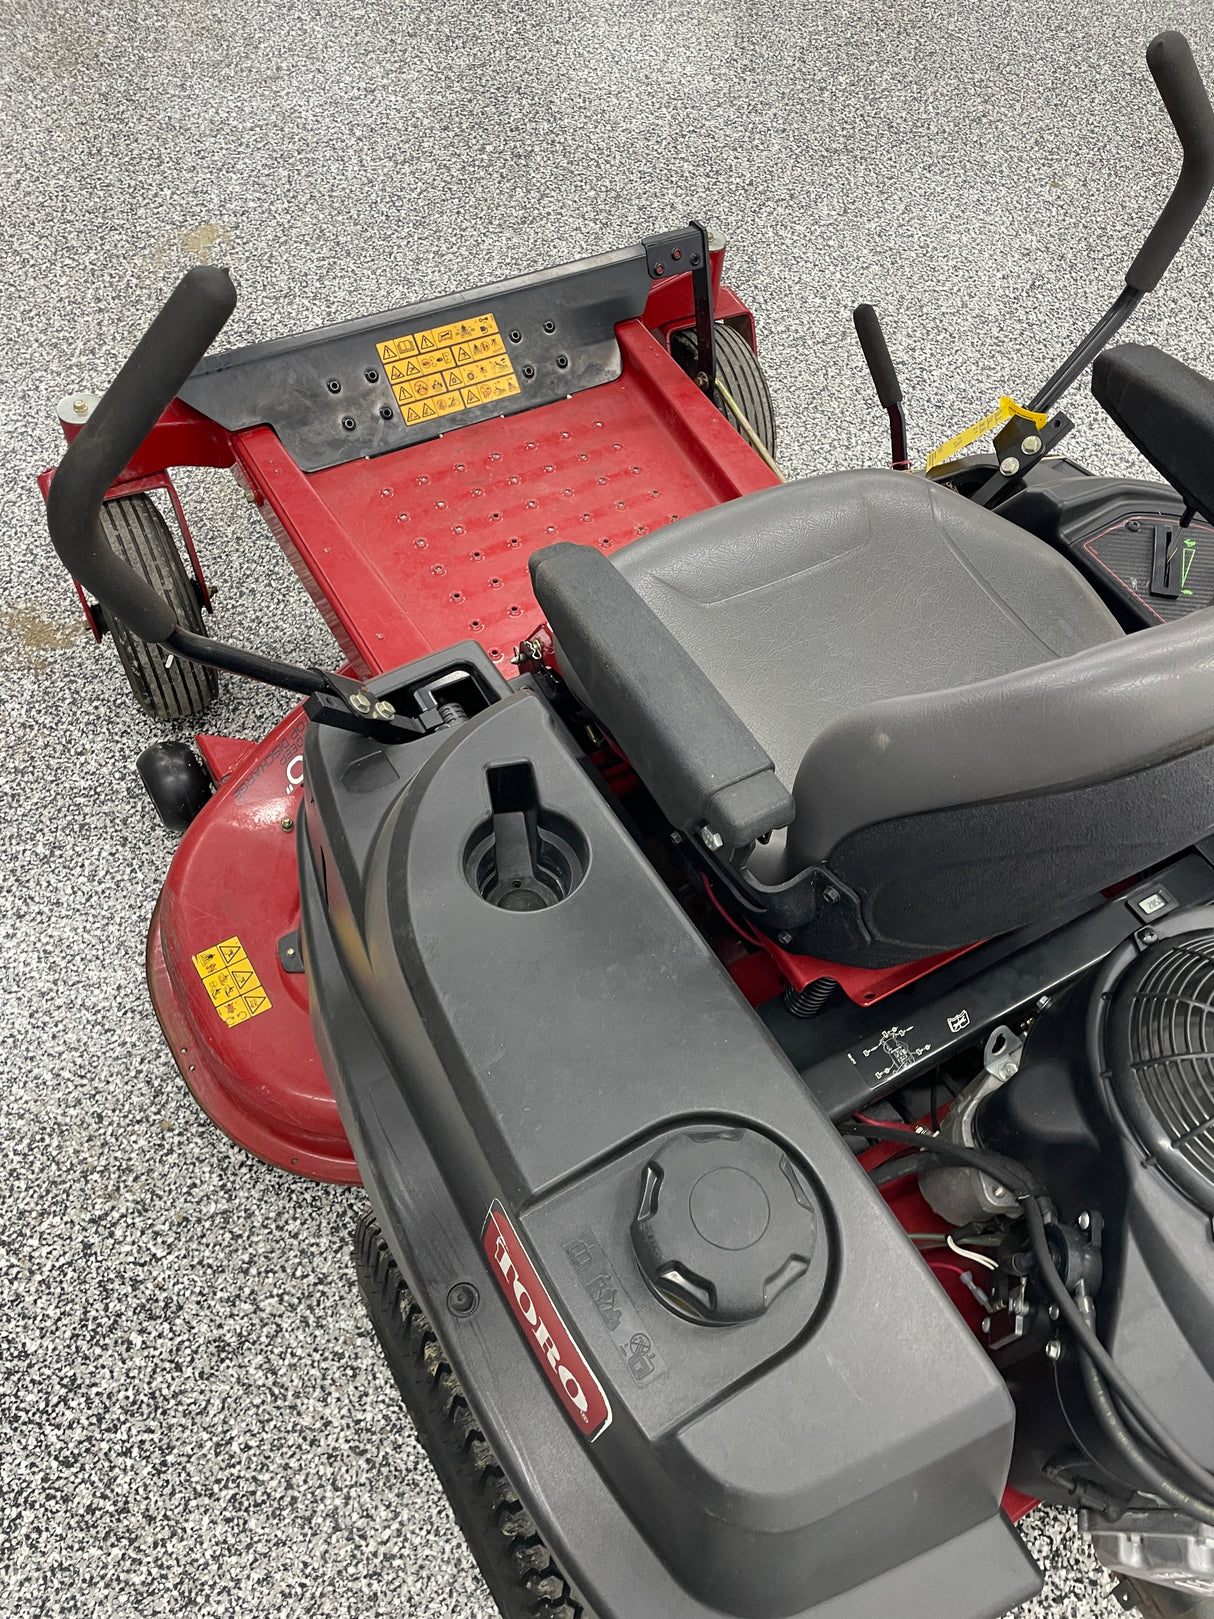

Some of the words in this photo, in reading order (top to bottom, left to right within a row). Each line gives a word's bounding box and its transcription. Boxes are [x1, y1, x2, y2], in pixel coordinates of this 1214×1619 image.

[234, 737, 290, 800] DISCHARGE
[280, 736, 304, 766] DEEP
[494, 1236, 588, 1412] TORO
